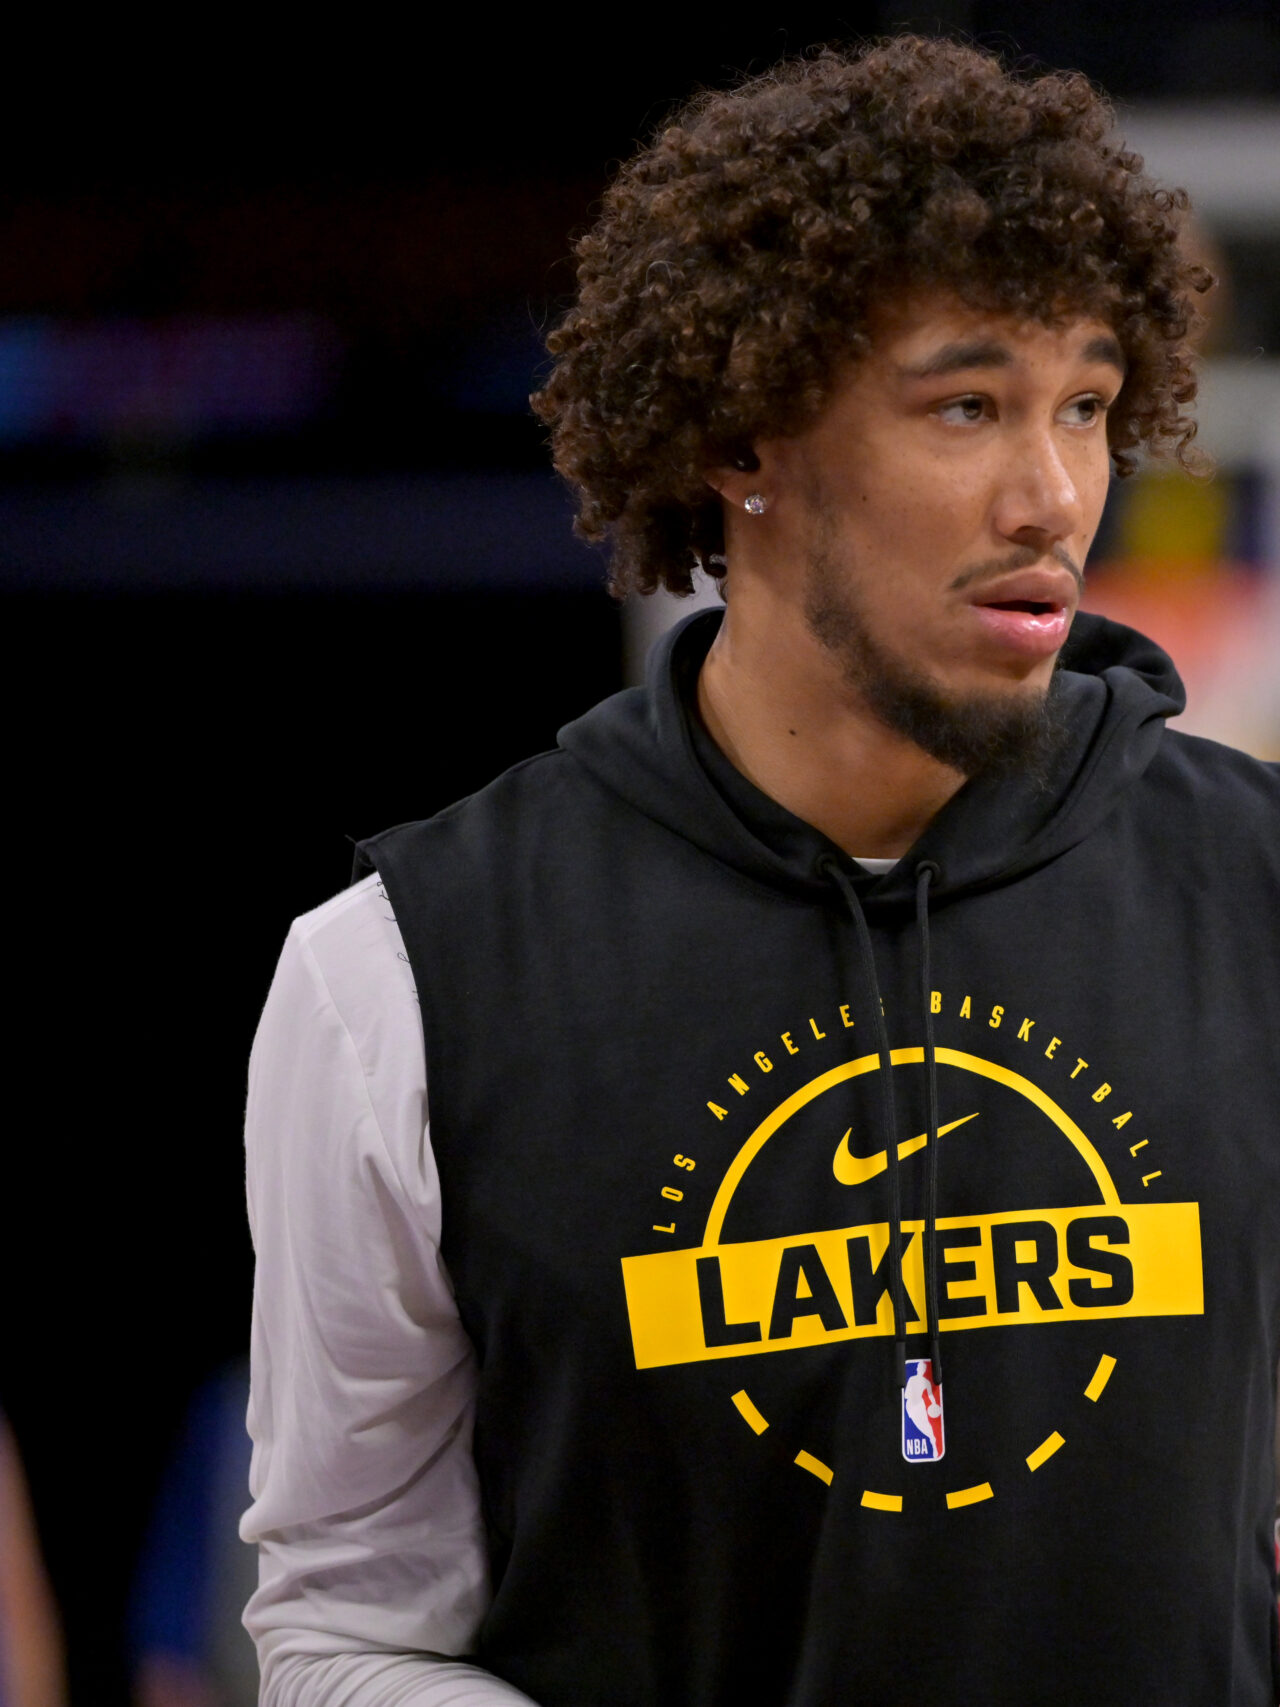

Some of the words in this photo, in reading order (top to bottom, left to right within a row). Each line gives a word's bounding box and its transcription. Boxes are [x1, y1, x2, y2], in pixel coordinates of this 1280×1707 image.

[653, 1153, 696, 1234] LOS
[707, 997, 885, 1121] ANGELE
[930, 990, 1162, 1188] BASKETBALL
[695, 1215, 1134, 1349] LAKERS
[906, 1438, 928, 1456] NBA
